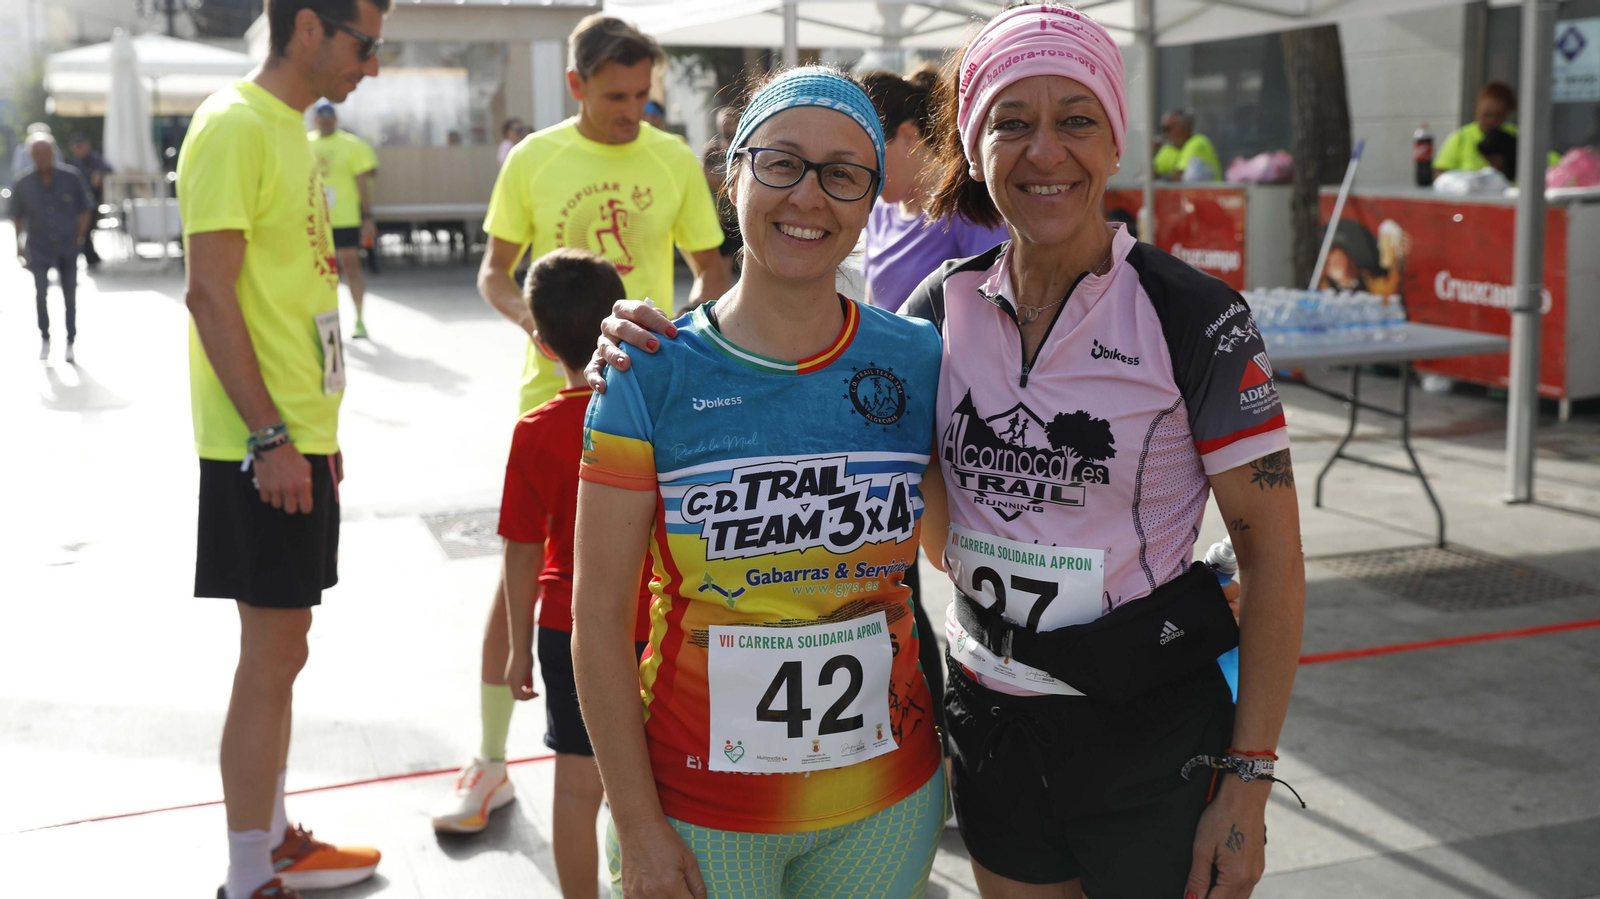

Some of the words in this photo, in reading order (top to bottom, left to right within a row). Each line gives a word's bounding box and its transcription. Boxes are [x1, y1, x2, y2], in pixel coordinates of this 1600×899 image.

[561, 181, 621, 218] POPULAR
[1434, 270, 1553, 314] Cruzcamo
[856, 369, 875, 380] TRAIL
[875, 369, 895, 381] TEAM
[865, 413, 899, 424] ALGECIRAS
[722, 431, 759, 452] Miel
[687, 489, 738, 516] C.D.
[740, 466, 848, 502] TRAIL
[954, 469, 1080, 505] TRAIL
[973, 496, 1045, 514] RUNNING
[711, 510, 822, 552] TEAM
[960, 535, 996, 557] CARRERA
[997, 545, 1047, 568] SOLIDARIA
[1050, 555, 1093, 572] APRON
[745, 566, 830, 587] Gabarras
[834, 562, 850, 580] &
[791, 580, 880, 598] www.gys.es
[972, 565, 1059, 632] 27
[719, 634, 735, 648] VII
[738, 635, 794, 650] CARRERA
[797, 628, 854, 649] SOLIDARIA
[856, 620, 883, 640] APRON
[1159, 629, 1185, 645] adidas
[756, 654, 864, 739] 42
